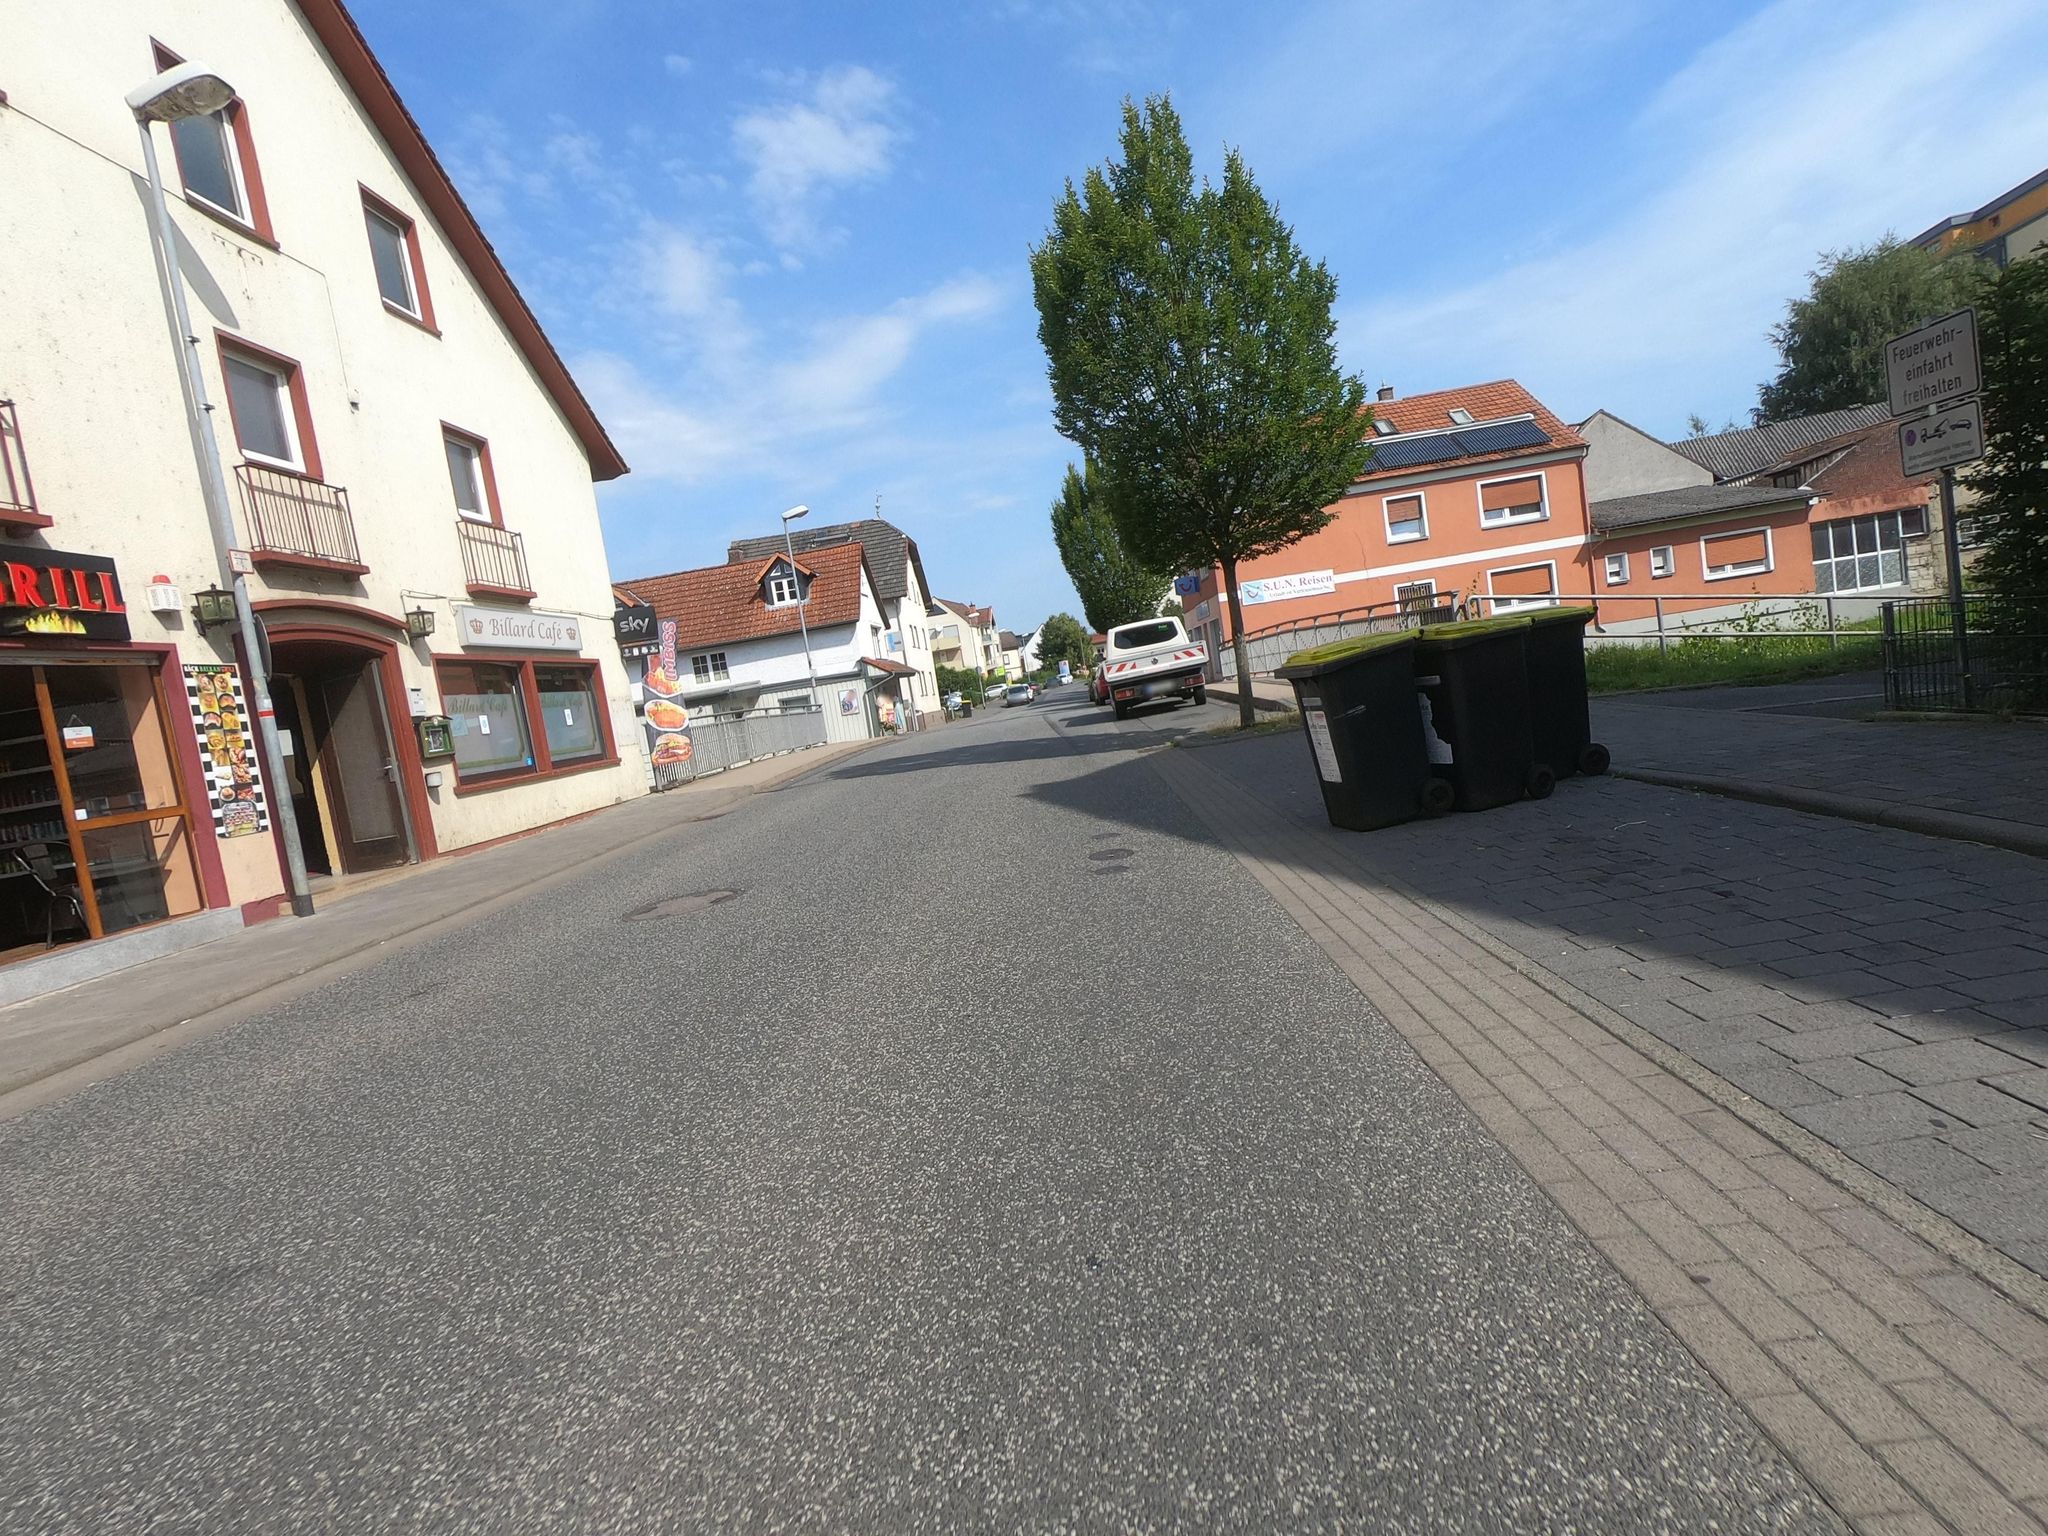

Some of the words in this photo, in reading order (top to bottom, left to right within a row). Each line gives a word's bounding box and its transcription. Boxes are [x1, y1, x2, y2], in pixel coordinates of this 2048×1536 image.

[1892, 327, 1963, 364] Feuerwehr-
[1905, 351, 1954, 382] einfahrt
[1903, 375, 1962, 405] freihalten
[1263, 578, 1296, 592] S.U.N.
[1299, 575, 1332, 587] Reisen
[489, 617, 535, 639] Billard
[538, 620, 562, 646] Café
[619, 615, 650, 633] sky
[662, 621, 678, 681] IMBISS
